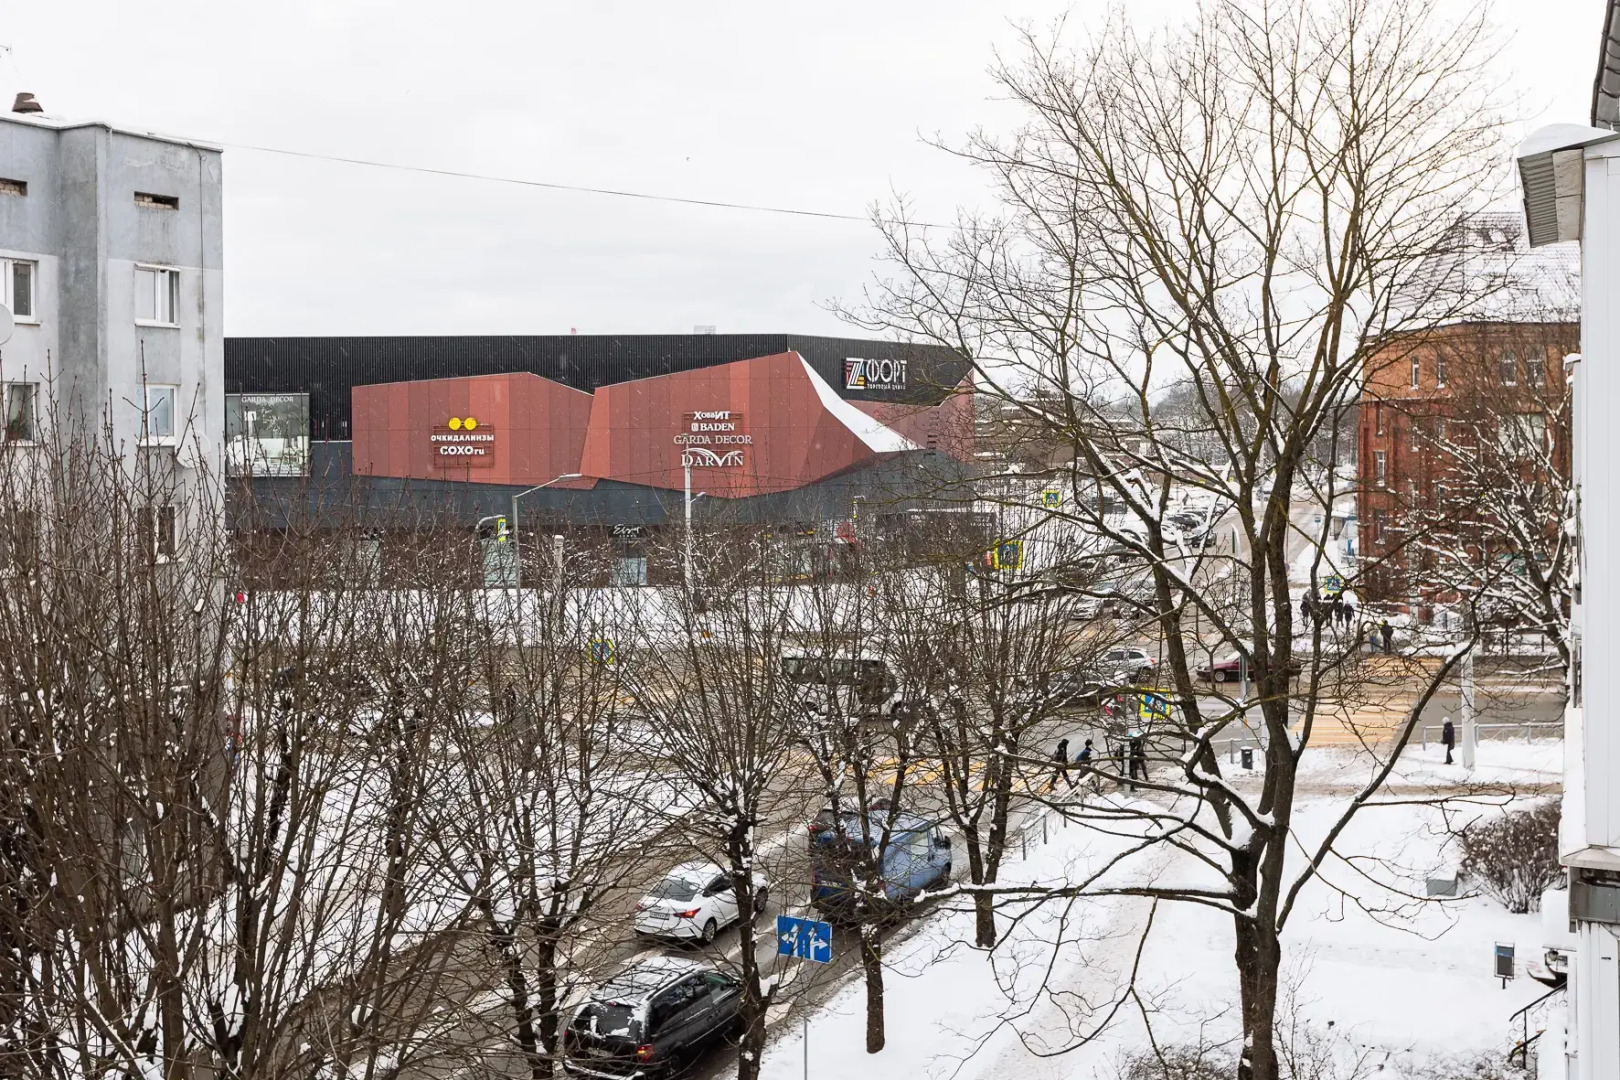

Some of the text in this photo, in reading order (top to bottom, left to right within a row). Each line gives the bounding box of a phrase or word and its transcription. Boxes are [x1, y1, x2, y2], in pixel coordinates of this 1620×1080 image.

[700, 423, 735, 431] BADEN
[673, 435, 753, 444] GARDA DECOR
